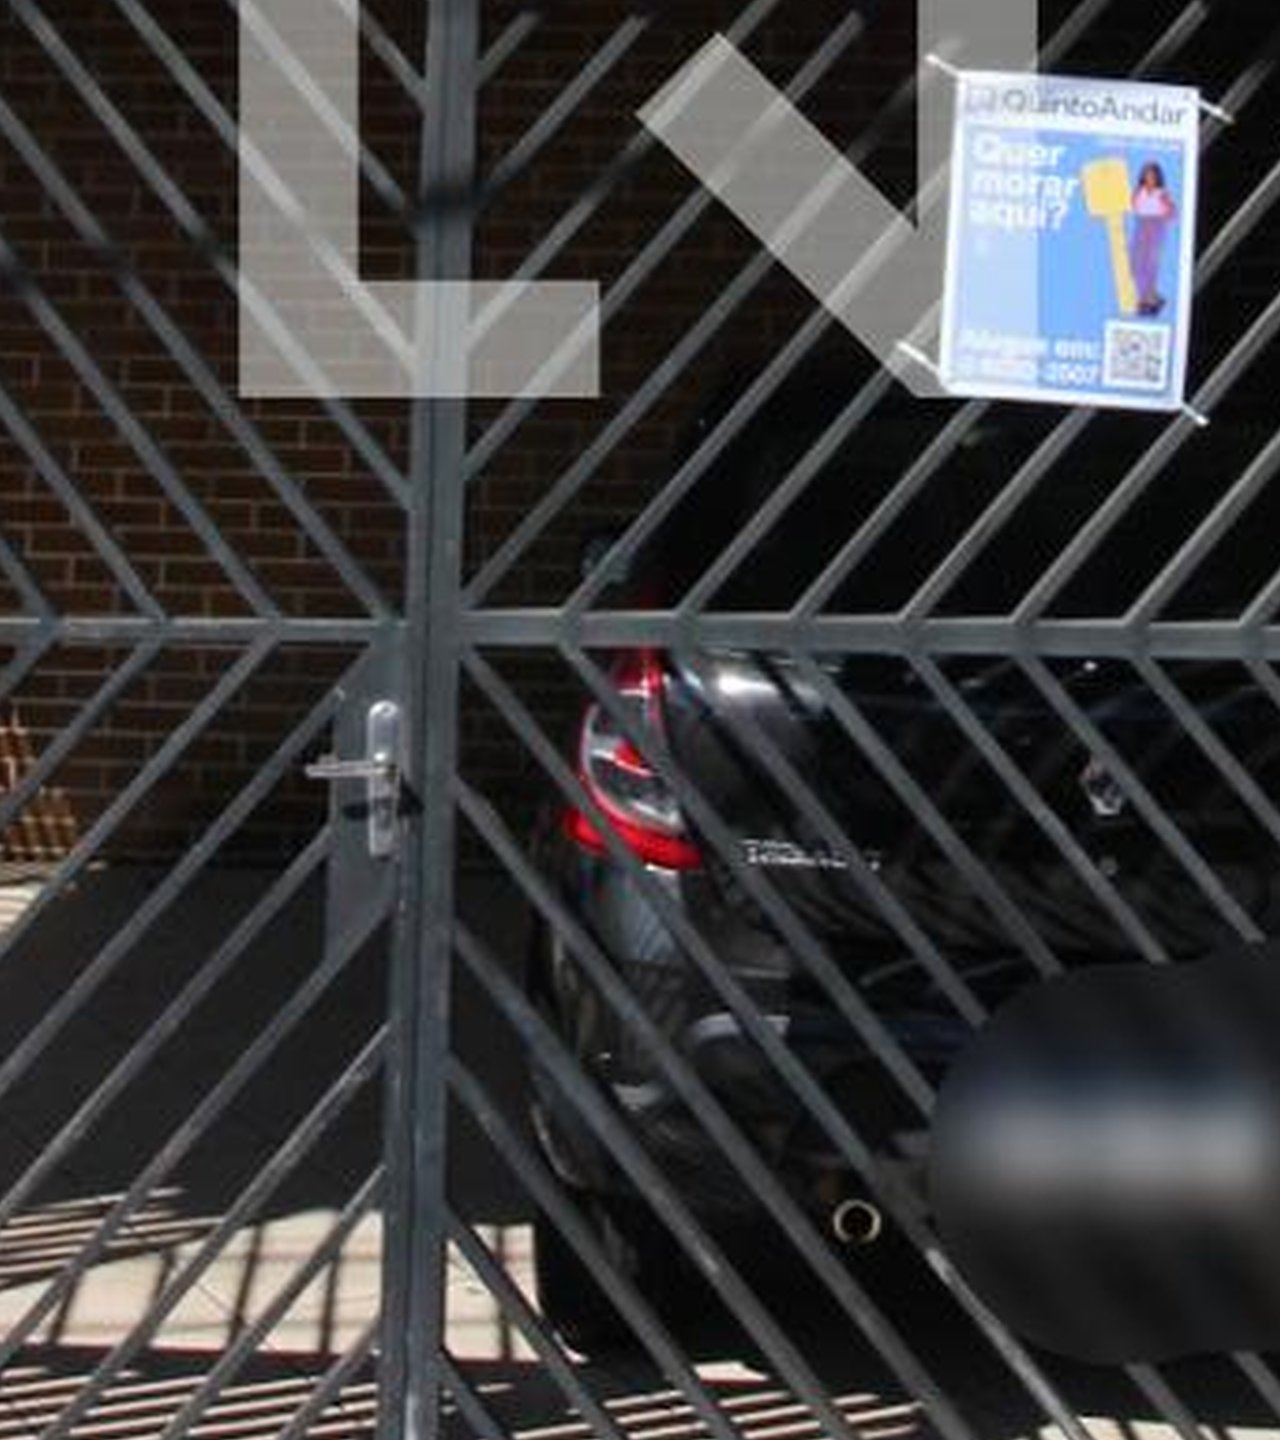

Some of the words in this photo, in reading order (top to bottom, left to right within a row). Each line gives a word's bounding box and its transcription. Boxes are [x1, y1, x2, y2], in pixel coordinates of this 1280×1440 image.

[1002, 88, 1188, 125] QuintoAndar
[971, 132, 1066, 167] Quer
[971, 170, 1080, 197] morar
